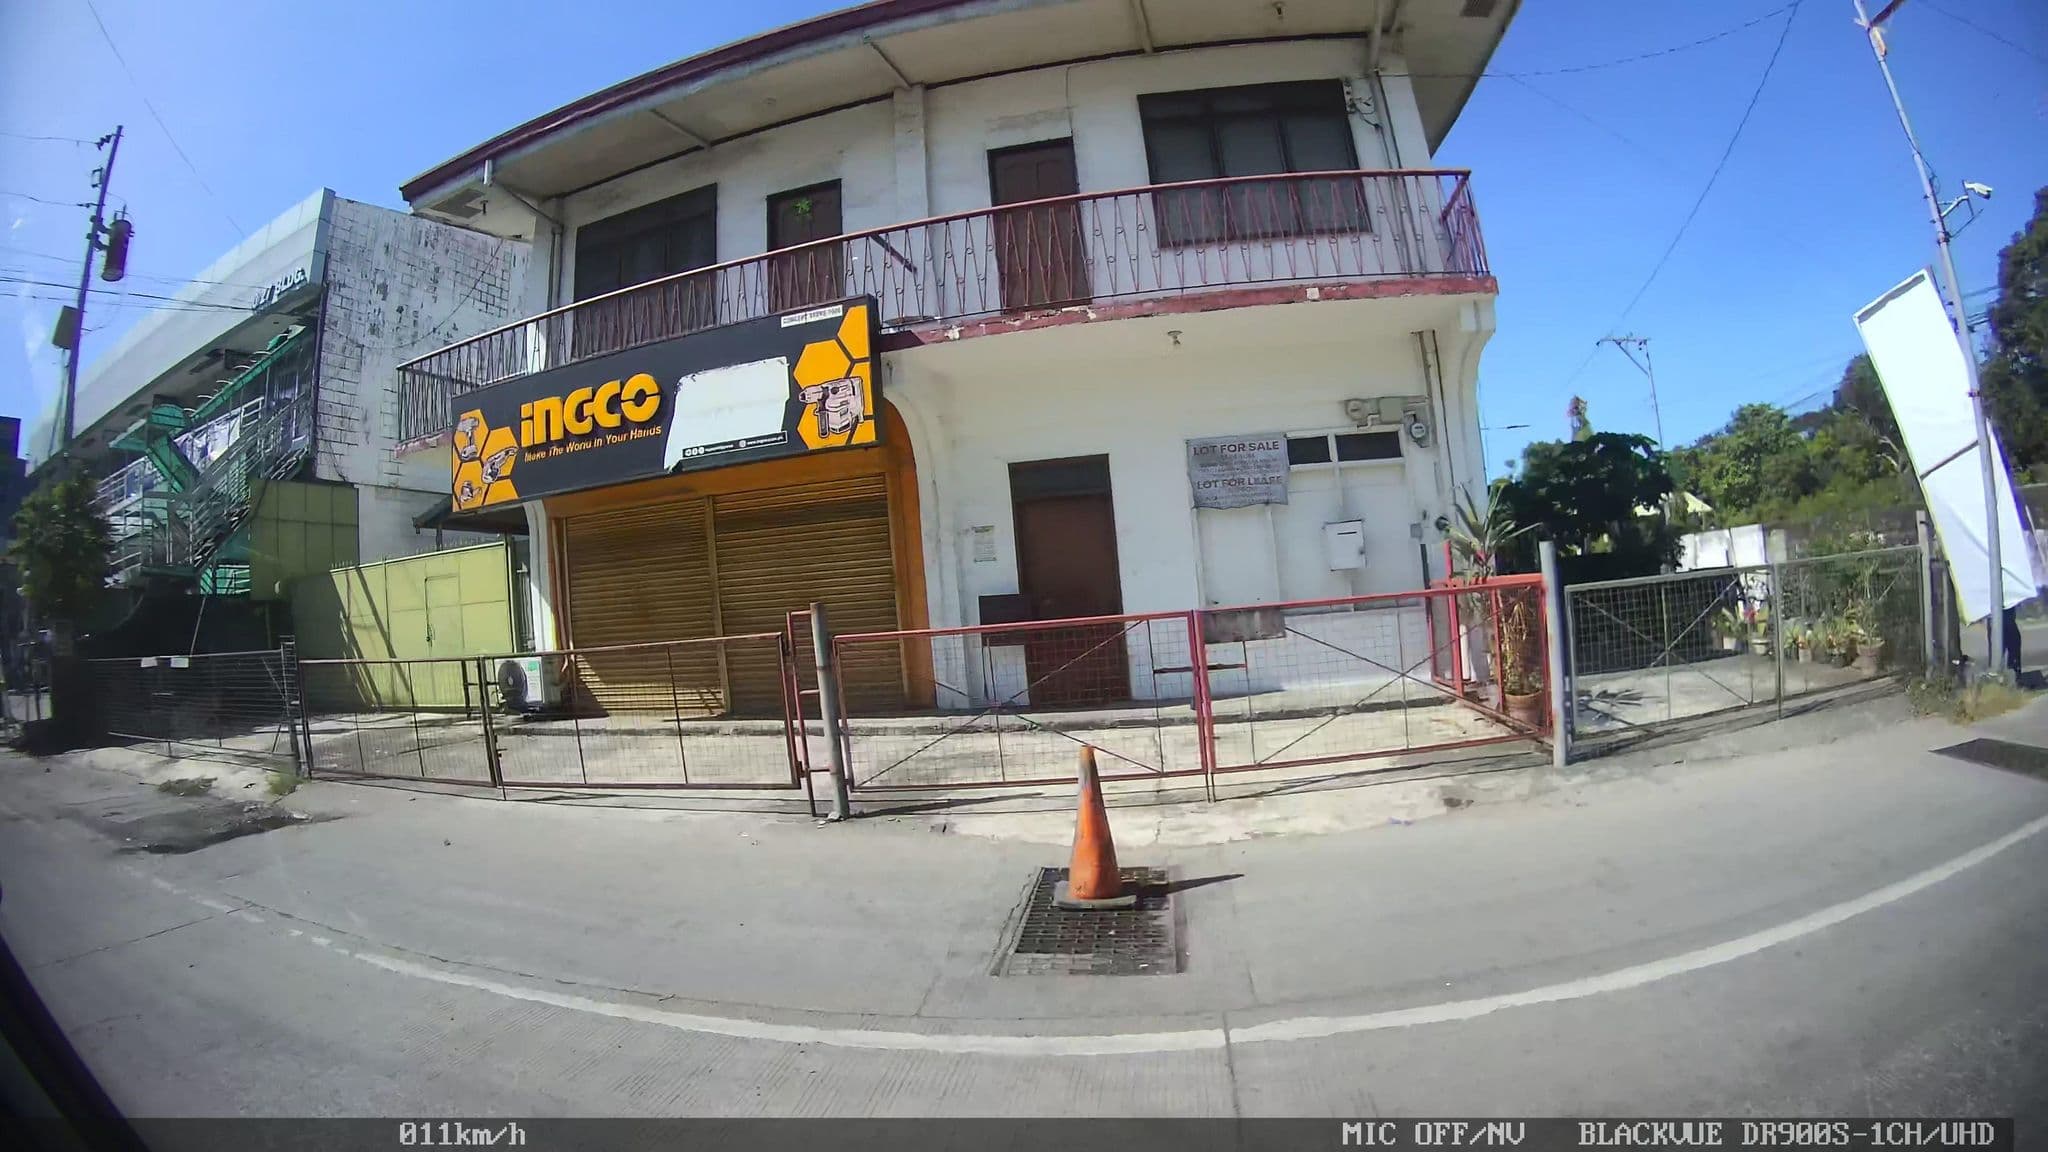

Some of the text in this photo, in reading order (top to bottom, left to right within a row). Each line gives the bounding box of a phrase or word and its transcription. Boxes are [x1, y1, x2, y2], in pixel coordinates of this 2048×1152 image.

[605, 432, 629, 445] Your
[1193, 446, 1217, 456] LOT
[1220, 443, 1246, 453] FOR
[1248, 440, 1280, 452] SALE
[1197, 480, 1219, 490] LOT
[1222, 478, 1246, 487] FOR
